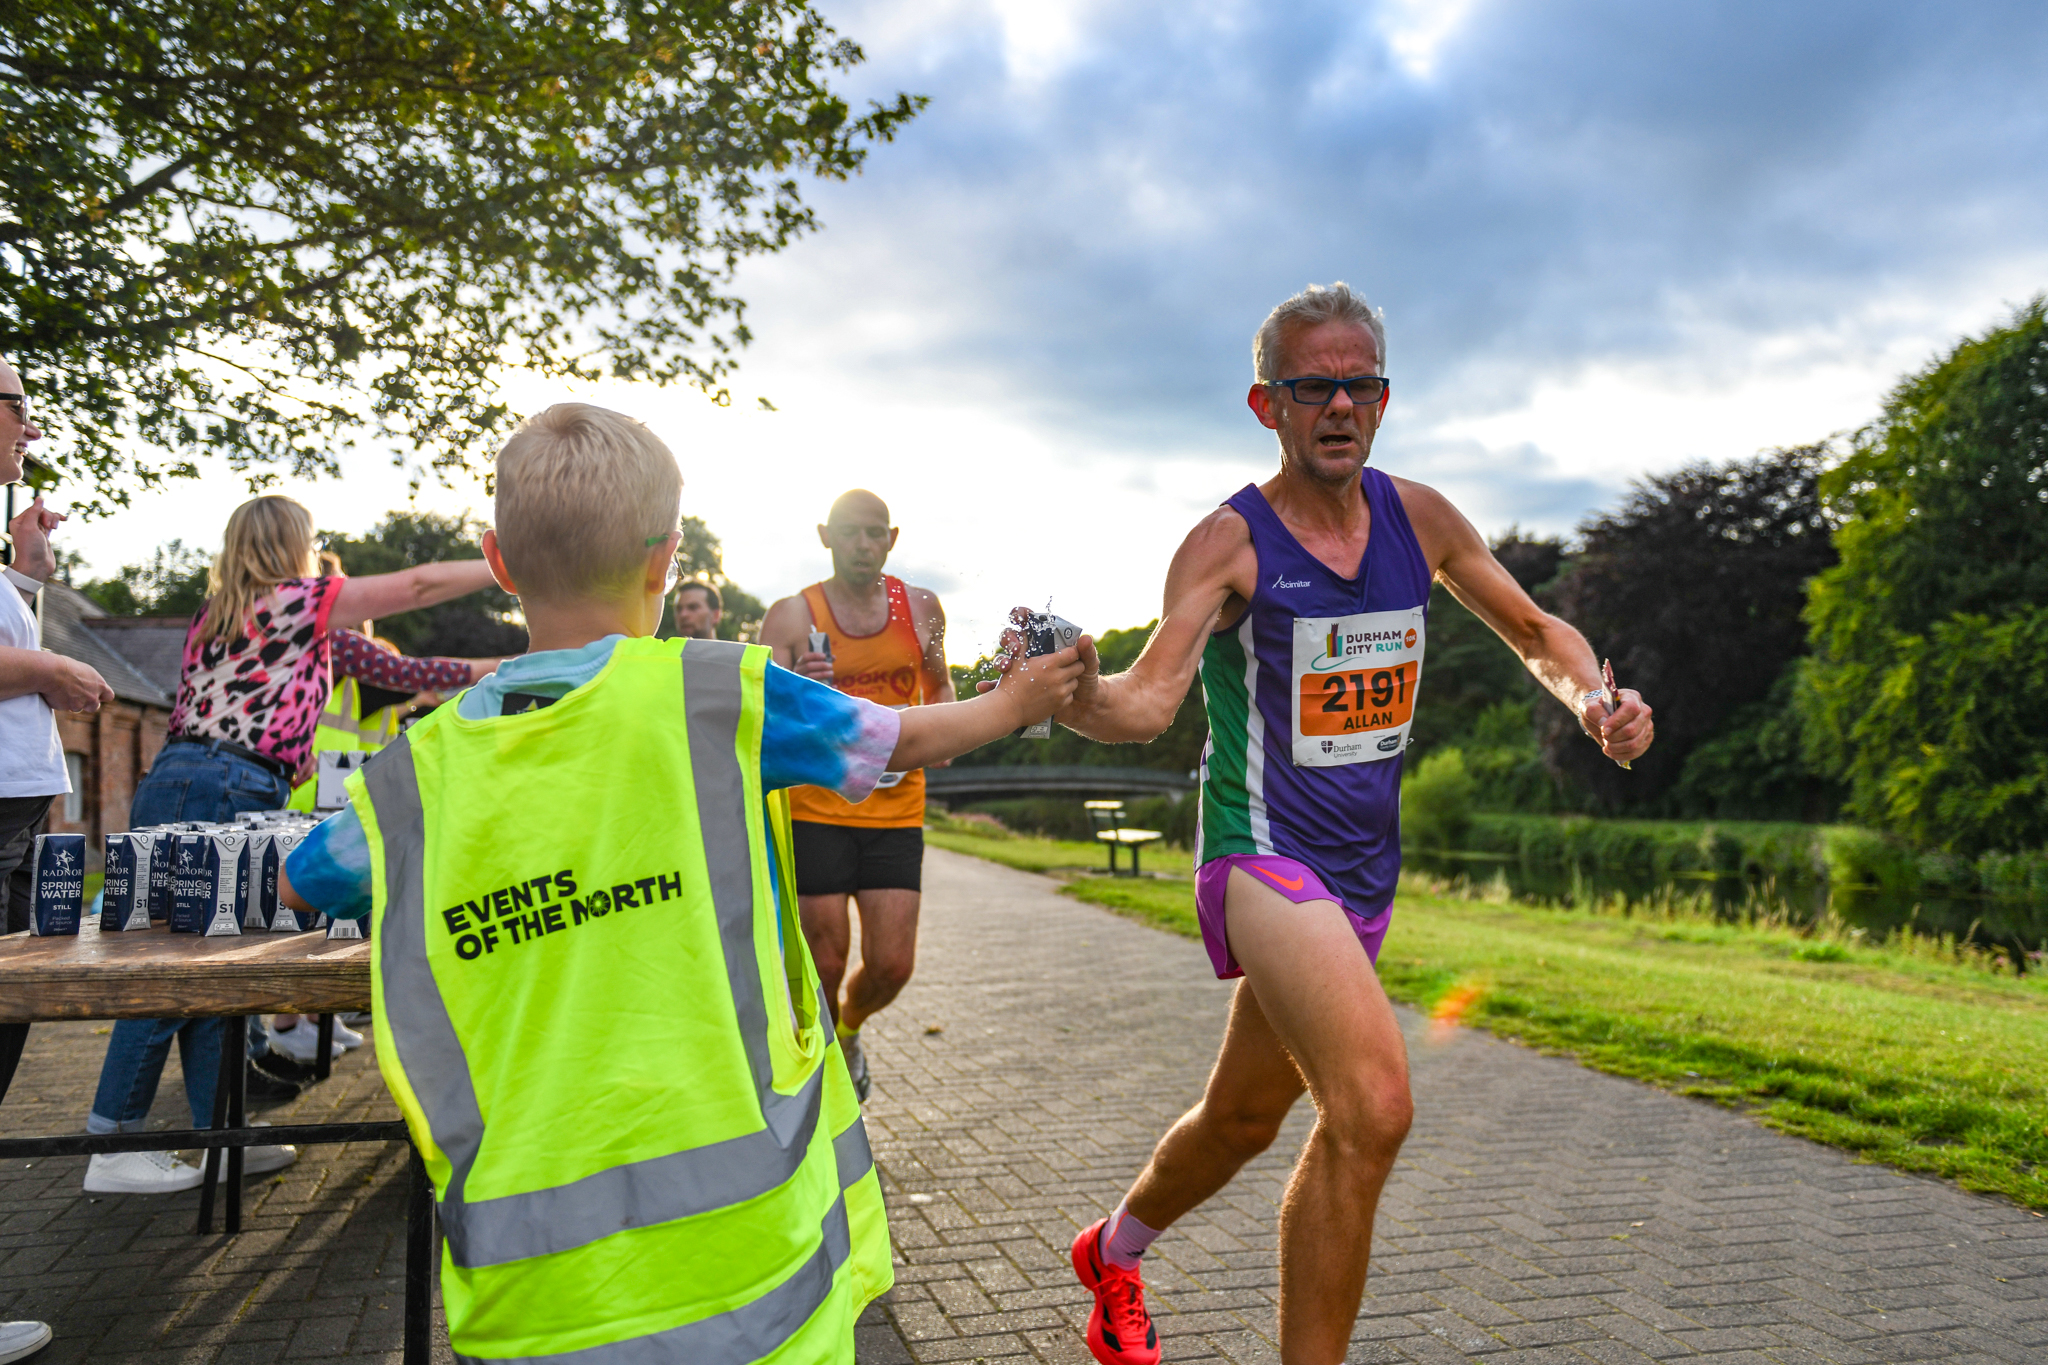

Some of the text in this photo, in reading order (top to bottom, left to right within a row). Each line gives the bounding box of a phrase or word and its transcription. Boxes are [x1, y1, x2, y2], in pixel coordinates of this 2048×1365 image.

[1280, 580, 1311, 589] Scimitar
[1346, 630, 1402, 644] DURHAM
[1405, 634, 1416, 643] 10K
[1346, 641, 1402, 655] CITY RUN
[1322, 667, 1405, 713] 2191
[1343, 711, 1393, 731] ALLAN
[1333, 743, 1362, 753] Durham
[42, 868, 82, 877] RADNOR
[105, 867, 129, 875] DNOR
[41, 881, 81, 890] SPRING
[41, 889, 81, 899] WATER
[104, 887, 127, 896] ATER
[136, 899, 147, 909] S1
[441, 869, 577, 935] EVENTS
[219, 903, 234, 914] S1
[455, 871, 682, 960] OF THE NORTH
